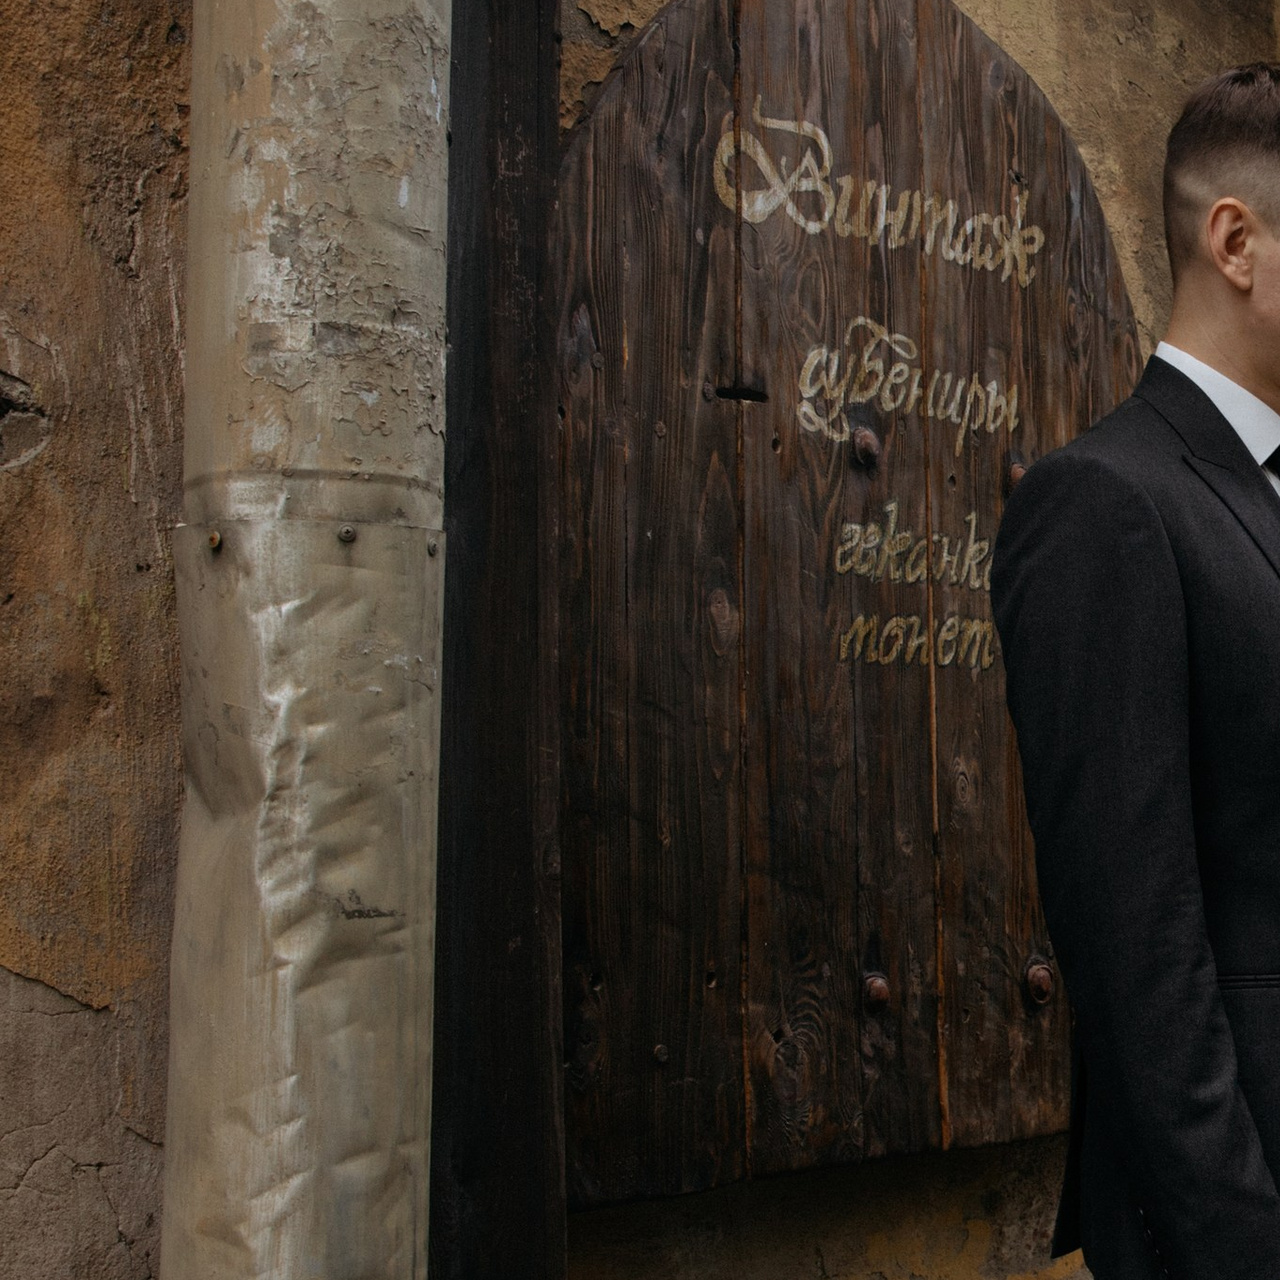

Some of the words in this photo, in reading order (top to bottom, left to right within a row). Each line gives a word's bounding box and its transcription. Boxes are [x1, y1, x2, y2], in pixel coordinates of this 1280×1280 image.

[713, 94, 1045, 289] Винтаж
[835, 501, 991, 592] чеканк
[839, 613, 994, 671] монет
